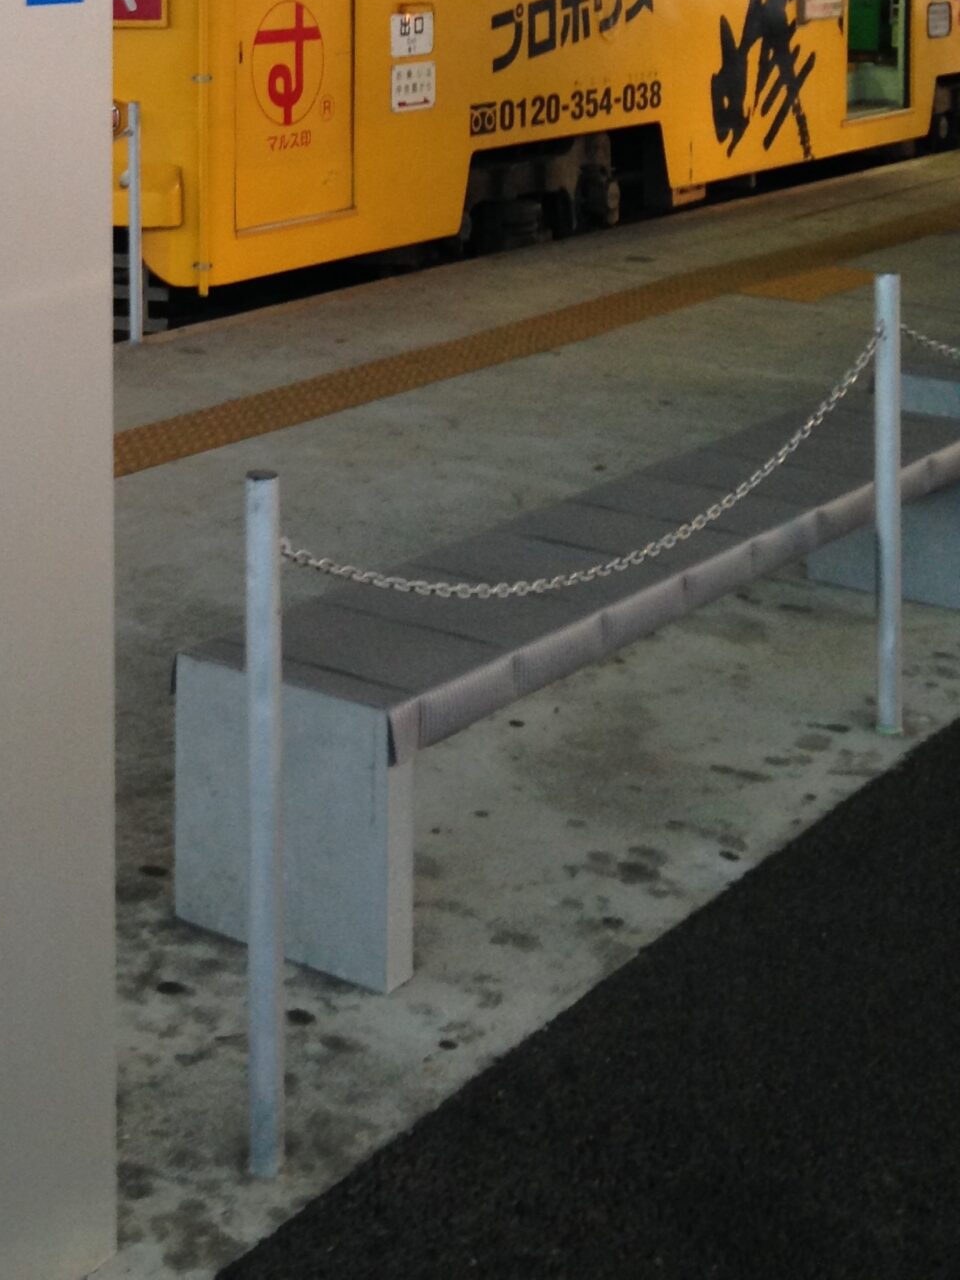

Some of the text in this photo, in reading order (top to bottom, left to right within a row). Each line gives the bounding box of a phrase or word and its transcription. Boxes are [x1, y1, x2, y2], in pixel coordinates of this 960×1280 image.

[499, 80, 662, 132] 0120-354-038
[266, 130, 312, 152] マルス印
